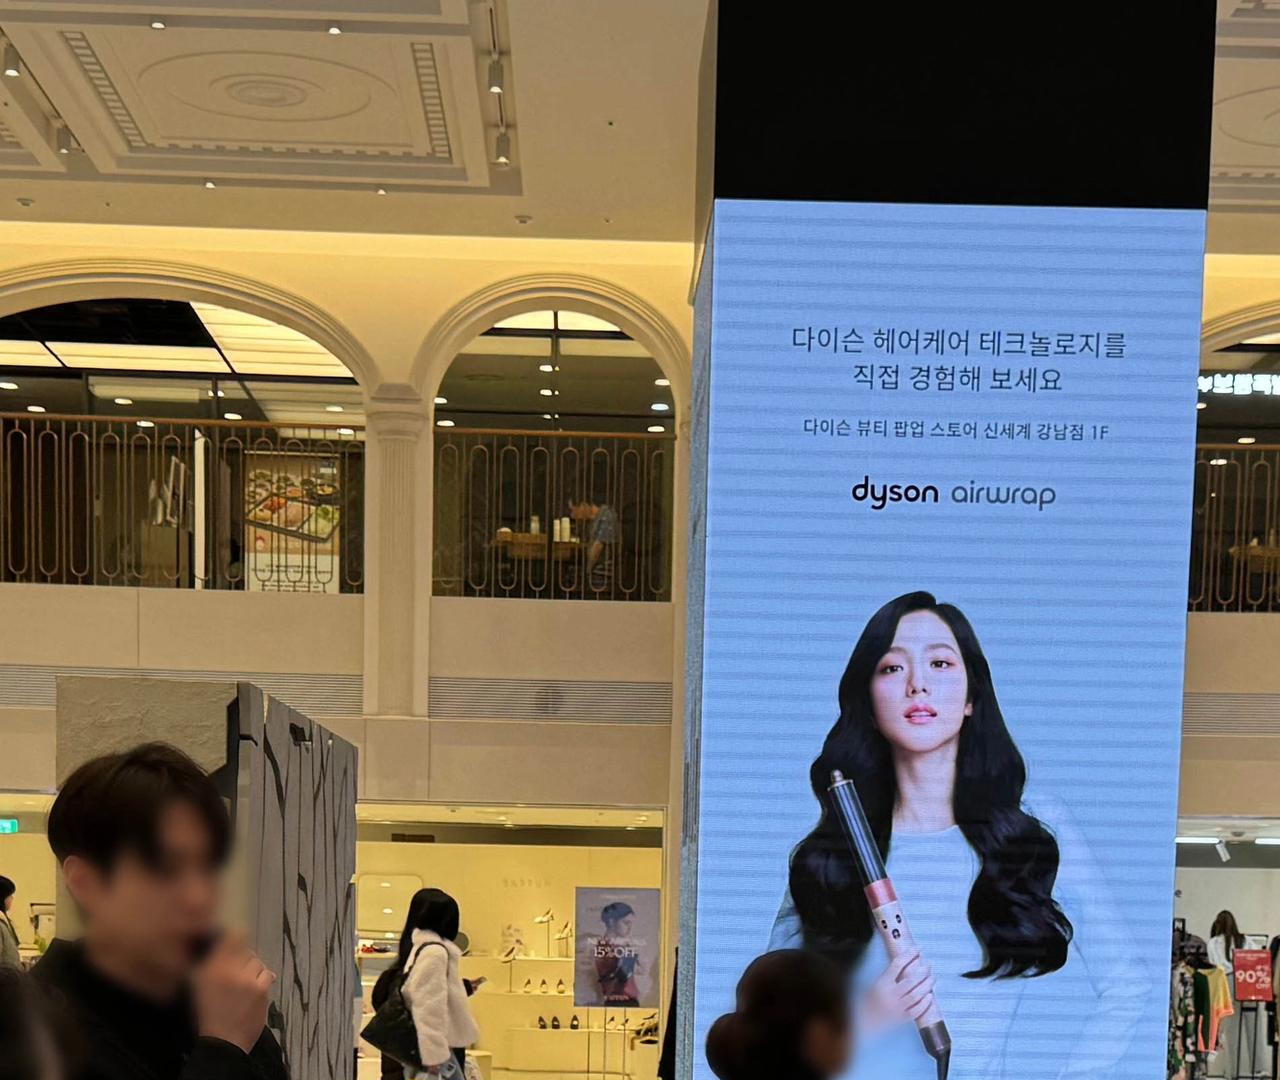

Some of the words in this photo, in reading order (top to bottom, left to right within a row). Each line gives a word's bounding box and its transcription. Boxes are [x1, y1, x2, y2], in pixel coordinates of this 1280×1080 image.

[792, 327, 865, 354] 다이슨
[873, 328, 970, 356] 헤어케어
[979, 330, 1127, 359] 테크놀로지를
[853, 364, 900, 391] 직접
[909, 365, 982, 392] 경험해
[989, 368, 1063, 393] 보세요
[803, 418, 851, 437] 다이슨
[856, 419, 888, 437] 뷰티
[894, 420, 925, 438] 팝업
[930, 421, 977, 439] 스토어
[983, 422, 1031, 440] 신세계
[1036, 423, 1084, 441] 강남점
[1091, 424, 1109, 440] 1F
[852, 475, 939, 510] dyson
[951, 480, 1056, 511] airwrap
